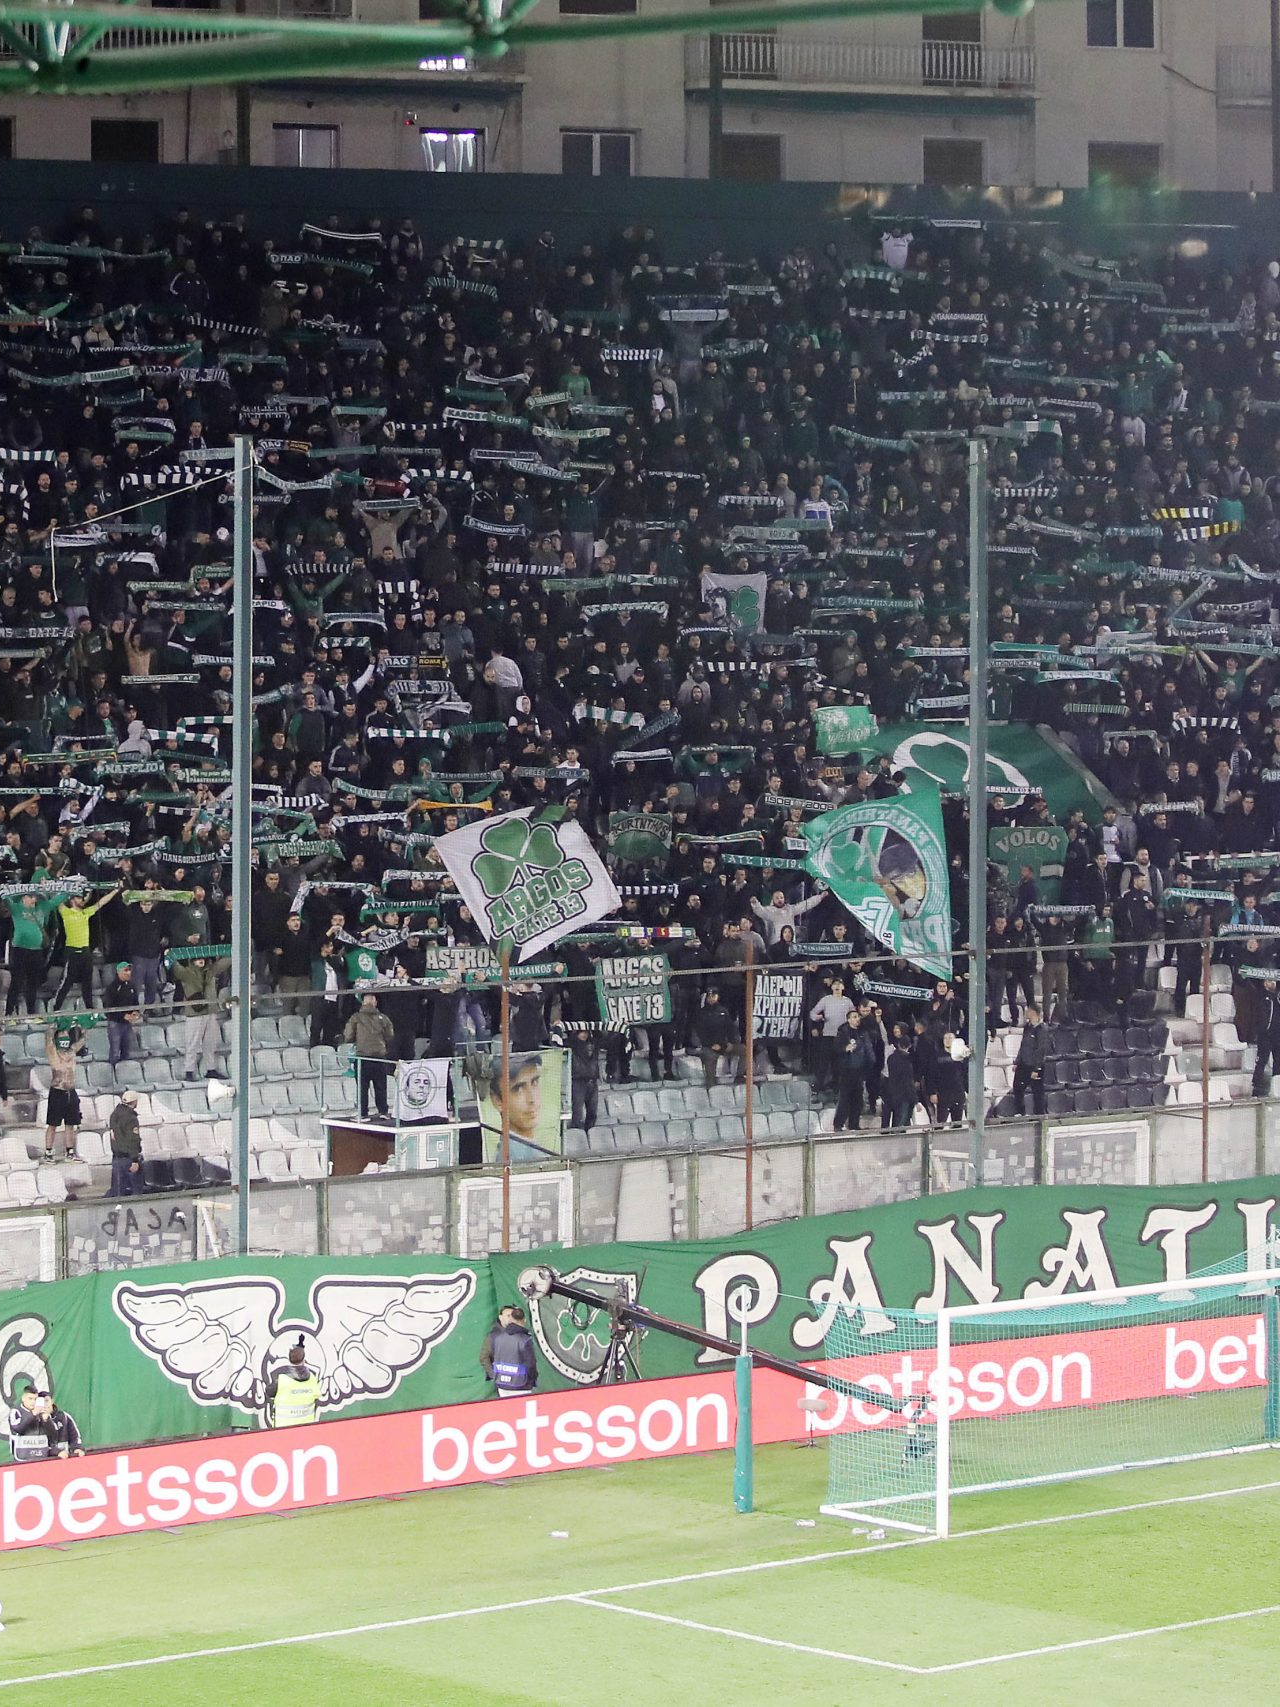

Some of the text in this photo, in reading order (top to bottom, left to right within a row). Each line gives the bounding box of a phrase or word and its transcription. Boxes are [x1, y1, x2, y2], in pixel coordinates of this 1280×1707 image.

[995, 829, 1061, 854] VOLOS
[488, 861, 591, 937] ARGOS
[426, 948, 500, 971] ASTROS
[481, 963, 552, 977] PANAHINAIKOS
[601, 956, 664, 988] ARGOS
[755, 975, 803, 996] ΑΔΕΡΦΙΑ
[874, 983, 923, 998] PANATHINAIKOS
[607, 993, 664, 1022] GATE 13
[753, 996, 802, 1017] ΚΡΑΤΑΤΕ
[1165, 1318, 1266, 1389] bet
[422, 1388, 729, 1483] betsson
[2, 1443, 340, 1544] betsson
